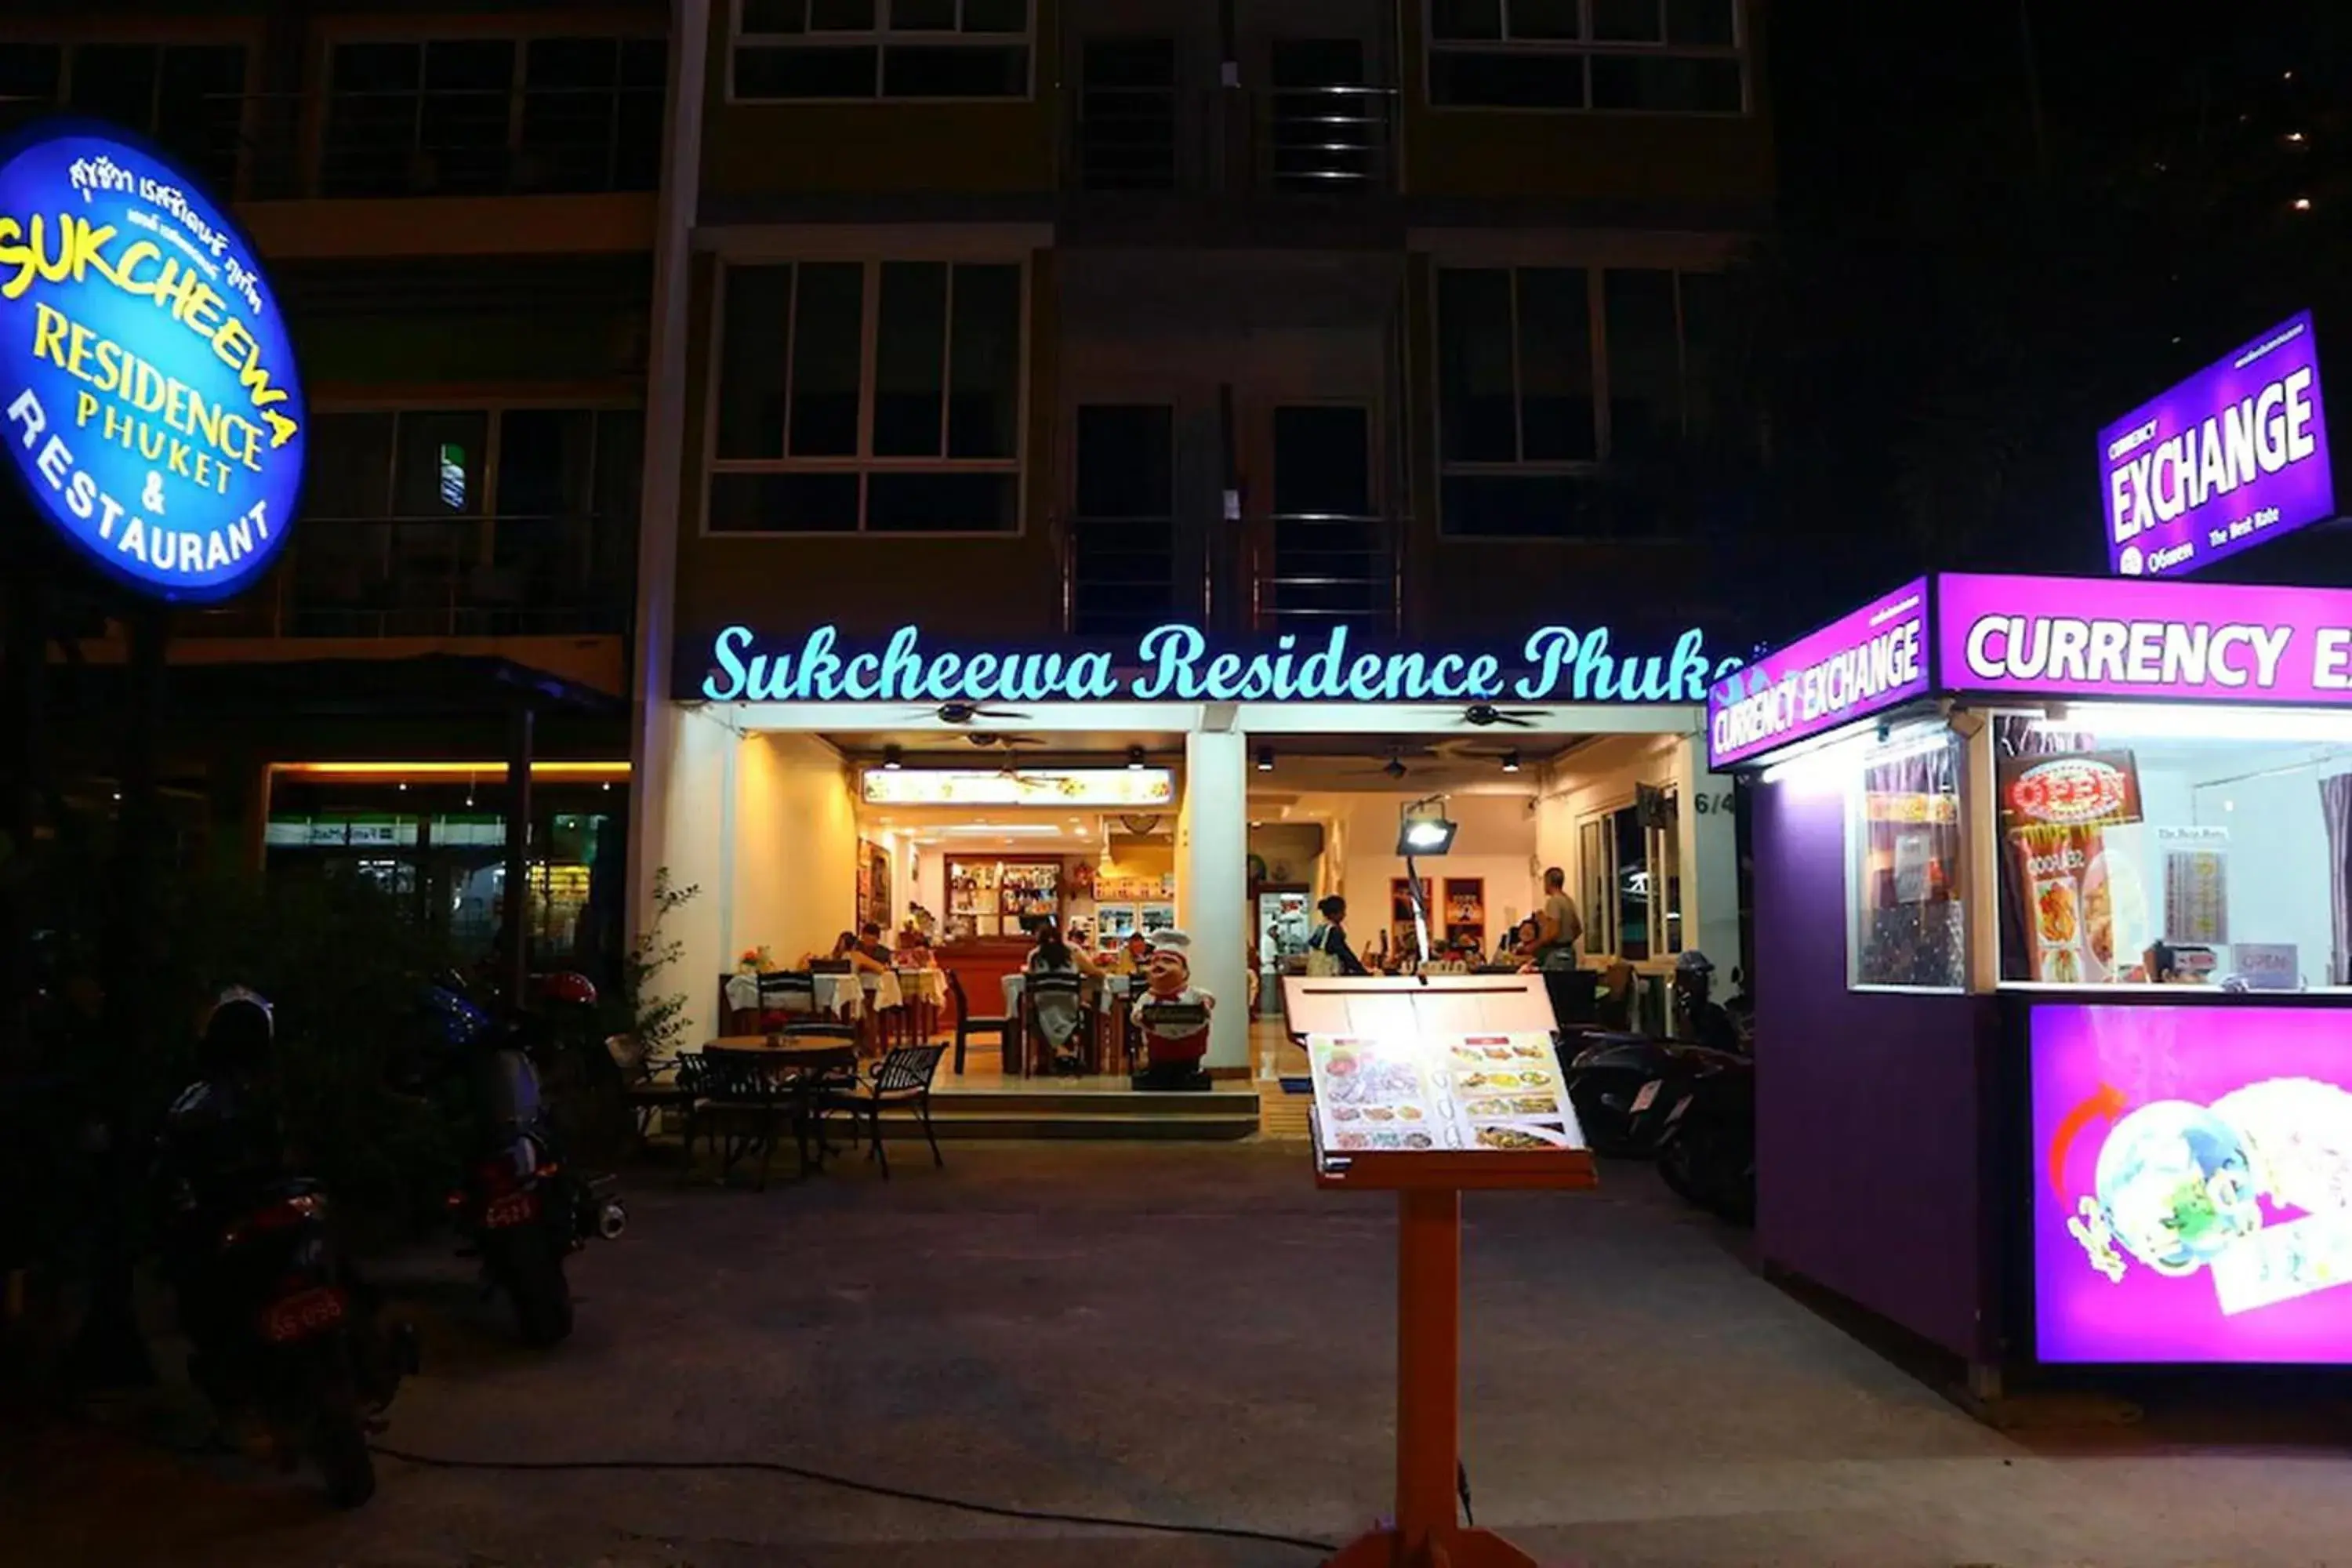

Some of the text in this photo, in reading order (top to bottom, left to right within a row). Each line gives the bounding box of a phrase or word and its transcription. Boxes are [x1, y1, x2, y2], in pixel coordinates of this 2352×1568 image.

[0, 212, 298, 449] SUKCHEEWA
[33, 303, 264, 472] RESIDENCE
[7, 389, 273, 572] RESTAURANT
[76, 390, 232, 495] PHUKET
[141, 470, 165, 515] &
[2111, 365, 2315, 544] EXCHANGE
[702, 624, 1744, 702] Sukcheewa Residence Phuk
[1714, 618, 1920, 754] CURRENCY EXCHANGE
[1966, 615, 2352, 691] CURRENCY E
[2013, 769, 2127, 811] OPEN
